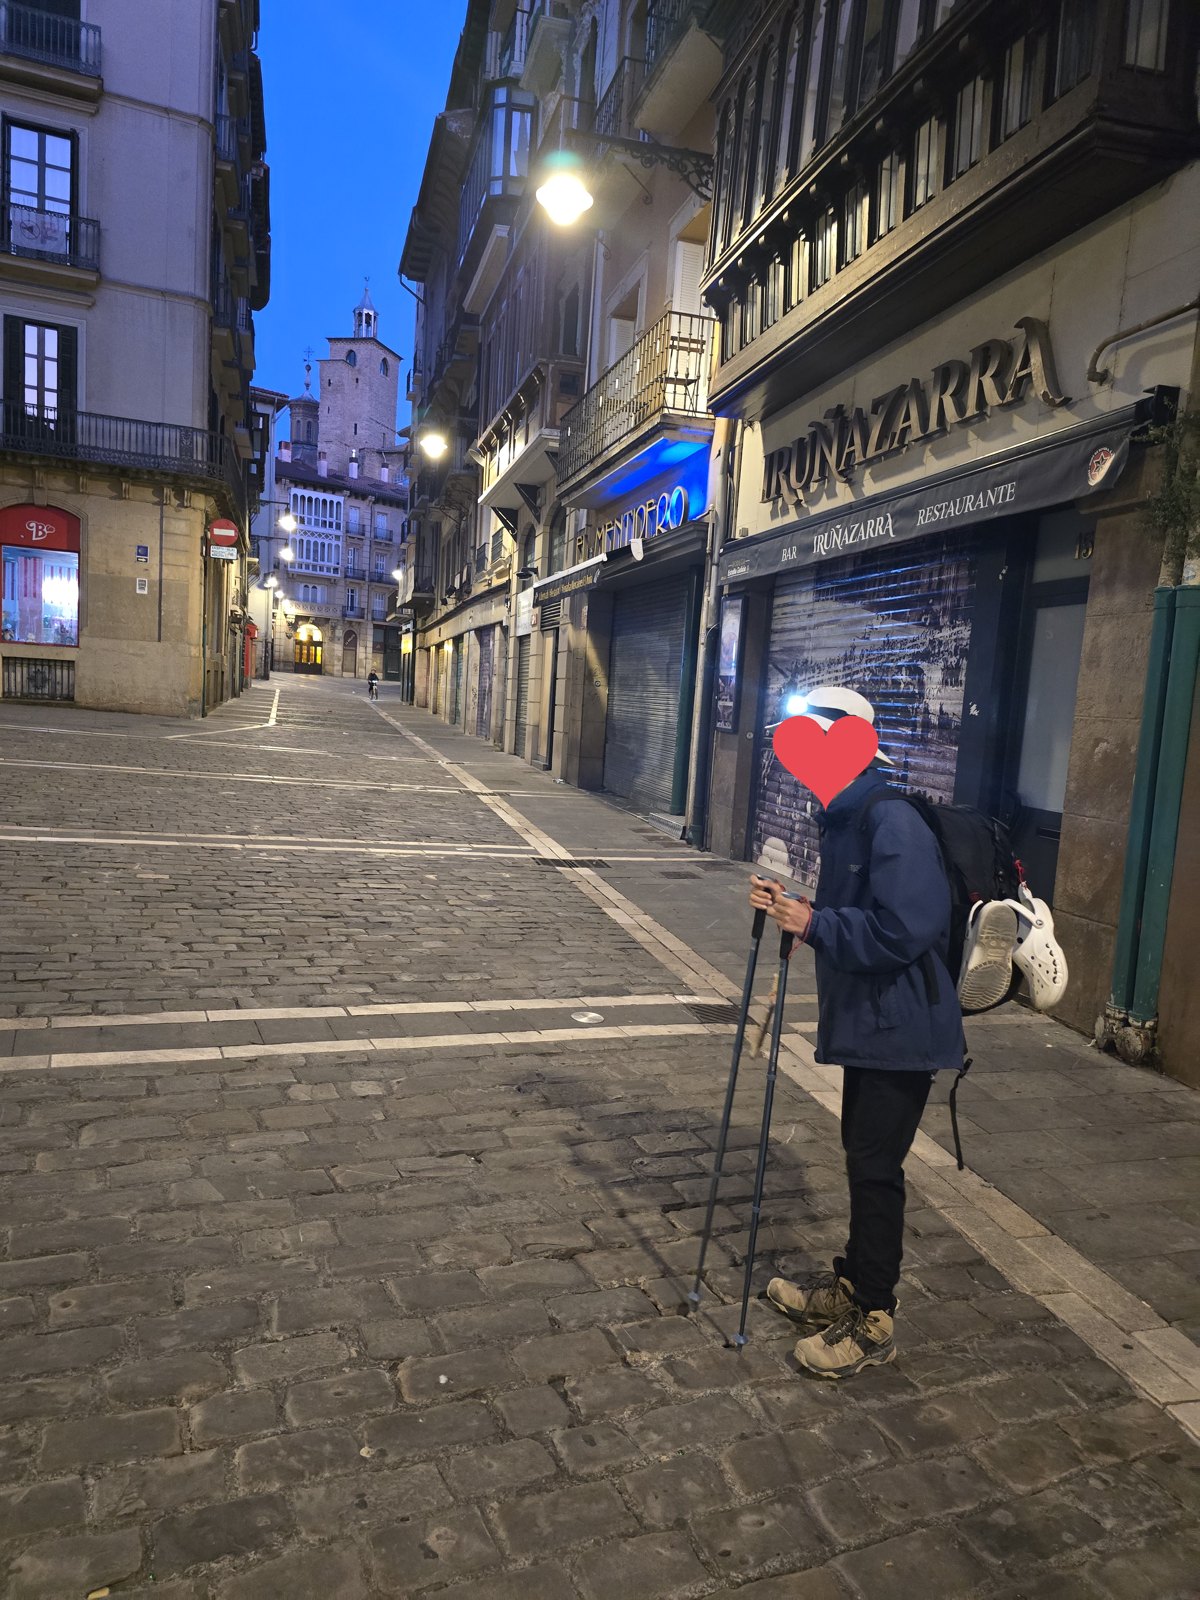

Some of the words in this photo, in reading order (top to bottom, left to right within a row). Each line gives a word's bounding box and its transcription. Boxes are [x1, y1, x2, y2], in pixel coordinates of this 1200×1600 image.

[760, 316, 1072, 505] IRUÑAZARRA
[593, 486, 686, 556] MENTIDERO
[782, 546, 797, 562] BAR
[813, 514, 895, 555] IRUÑAZARRA
[917, 482, 1016, 526] RESTAURANTE
